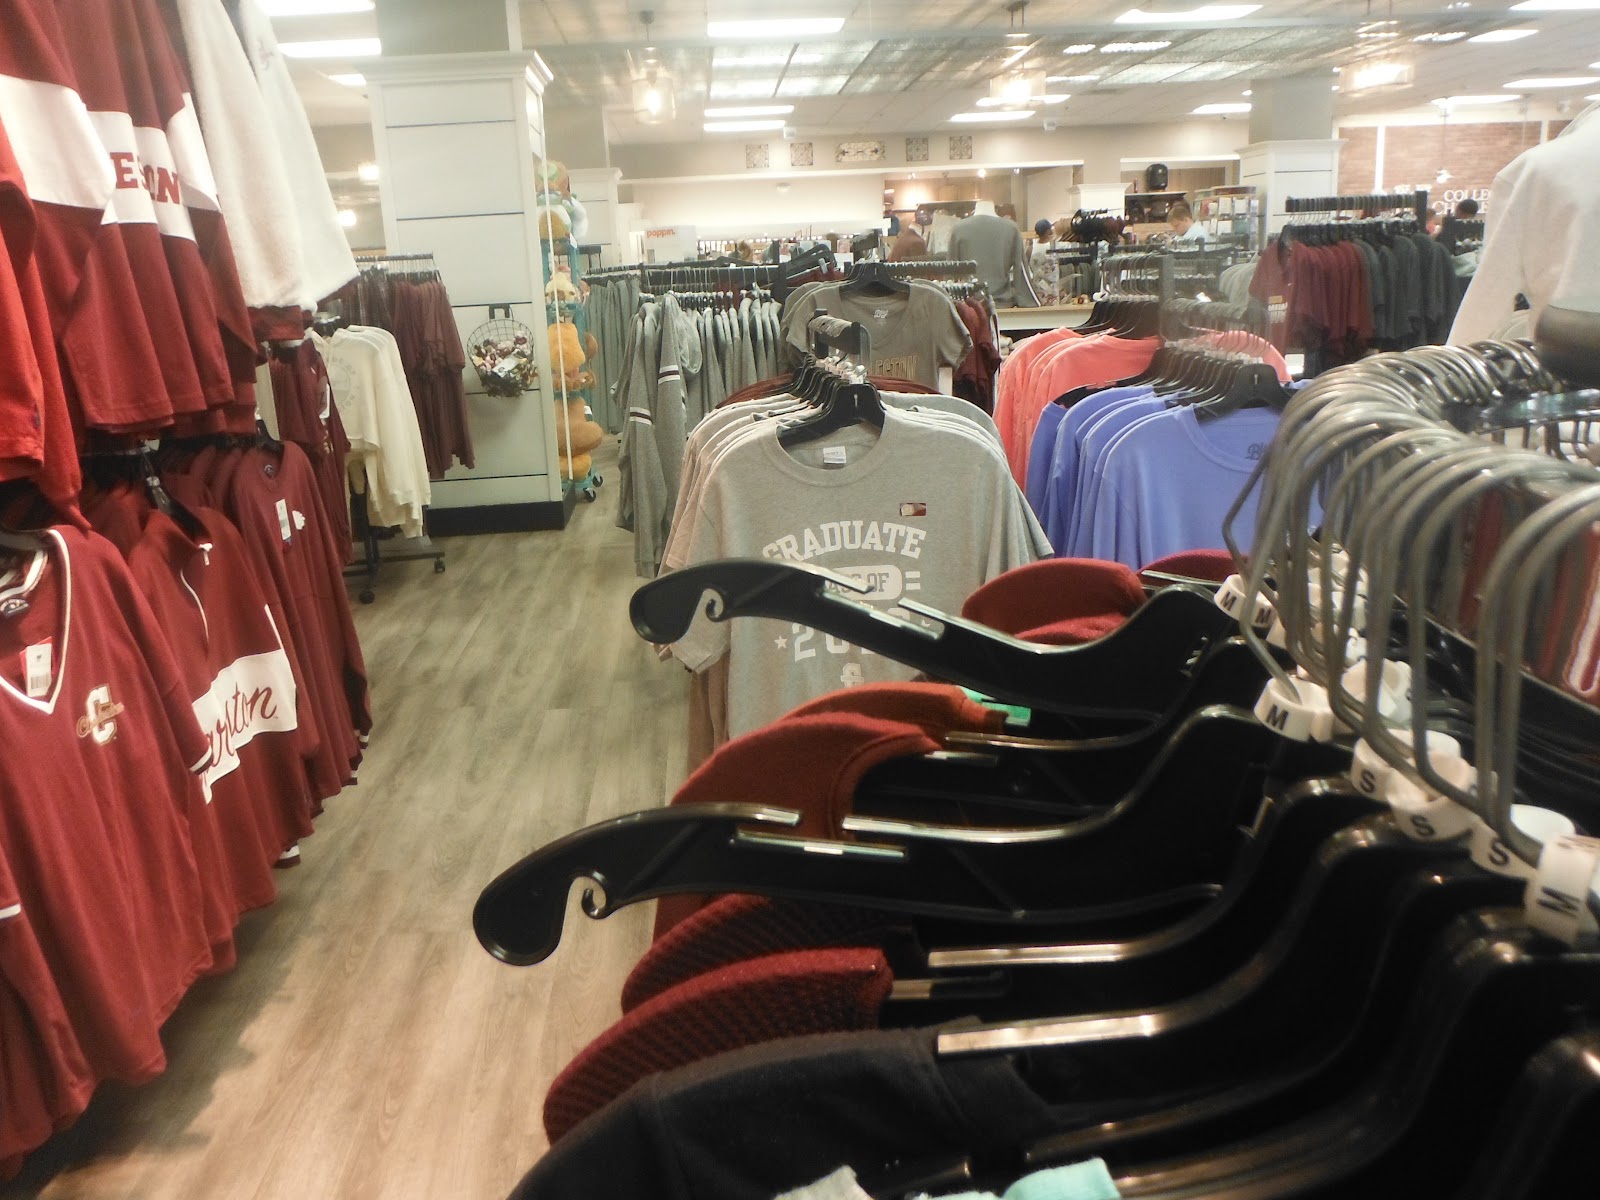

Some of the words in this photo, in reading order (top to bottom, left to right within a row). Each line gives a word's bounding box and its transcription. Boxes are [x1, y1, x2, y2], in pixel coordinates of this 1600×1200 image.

[762, 520, 927, 561] GRADUATE
[1221, 591, 1237, 612] M
[1255, 606, 1272, 625] M
[1265, 704, 1289, 731] M
[1360, 769, 1377, 794] S
[1410, 815, 1435, 837] S
[1488, 837, 1510, 866] S
[1537, 886, 1581, 918] M
